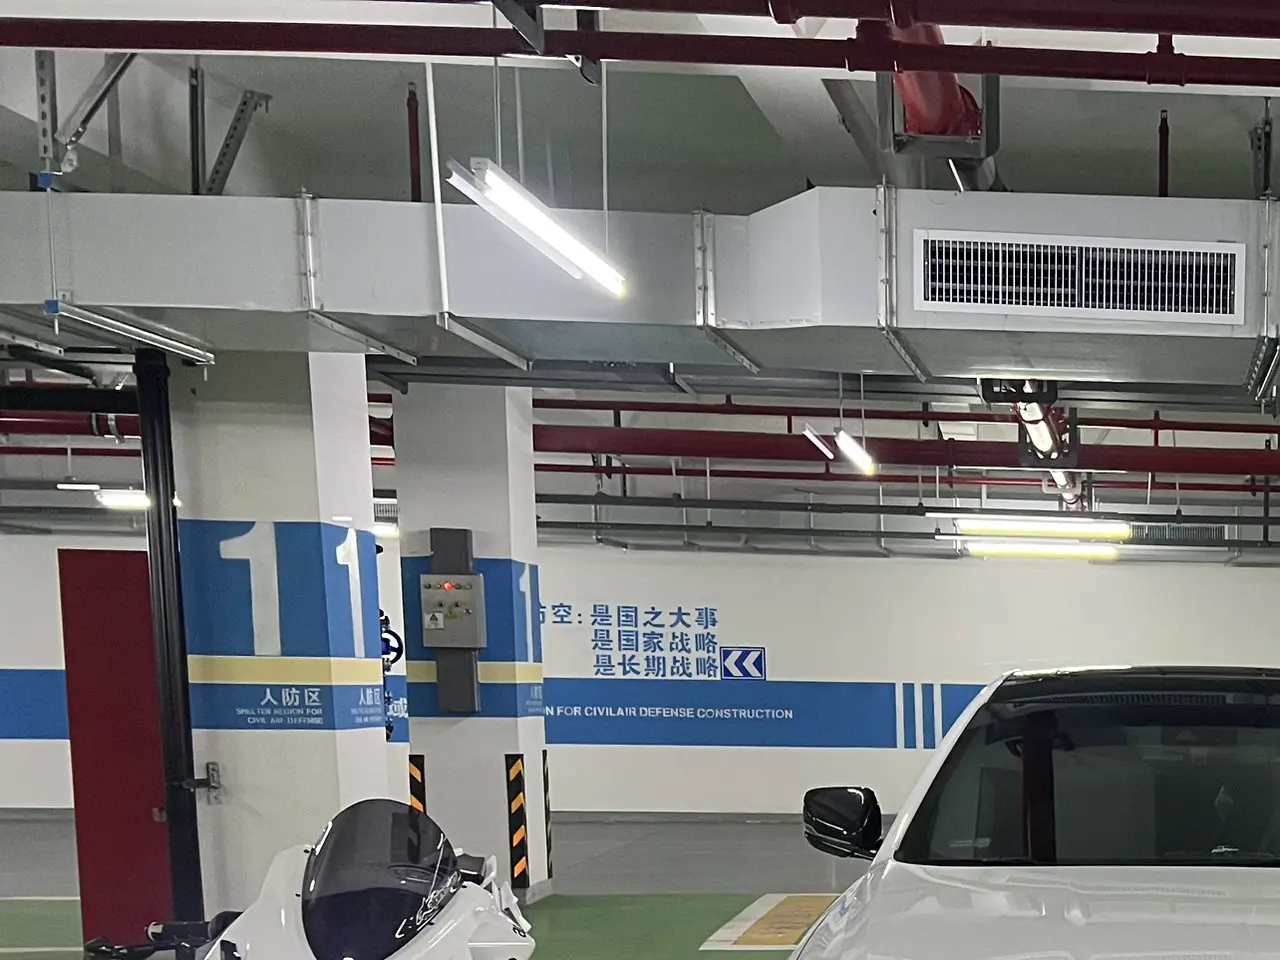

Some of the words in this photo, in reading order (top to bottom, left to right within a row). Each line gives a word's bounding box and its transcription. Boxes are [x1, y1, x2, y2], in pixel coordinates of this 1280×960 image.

[220, 521, 282, 656] 1
[336, 527, 366, 658] 1
[519, 563, 534, 662] 1
[591, 629, 718, 654] 是国家战略
[593, 654, 719, 678] 是长期战略
[260, 687, 322, 706] 人防区
[557, 706, 581, 716] FOR
[639, 707, 694, 717] DEFENSE
[697, 708, 793, 719] CONSTRUCTION
